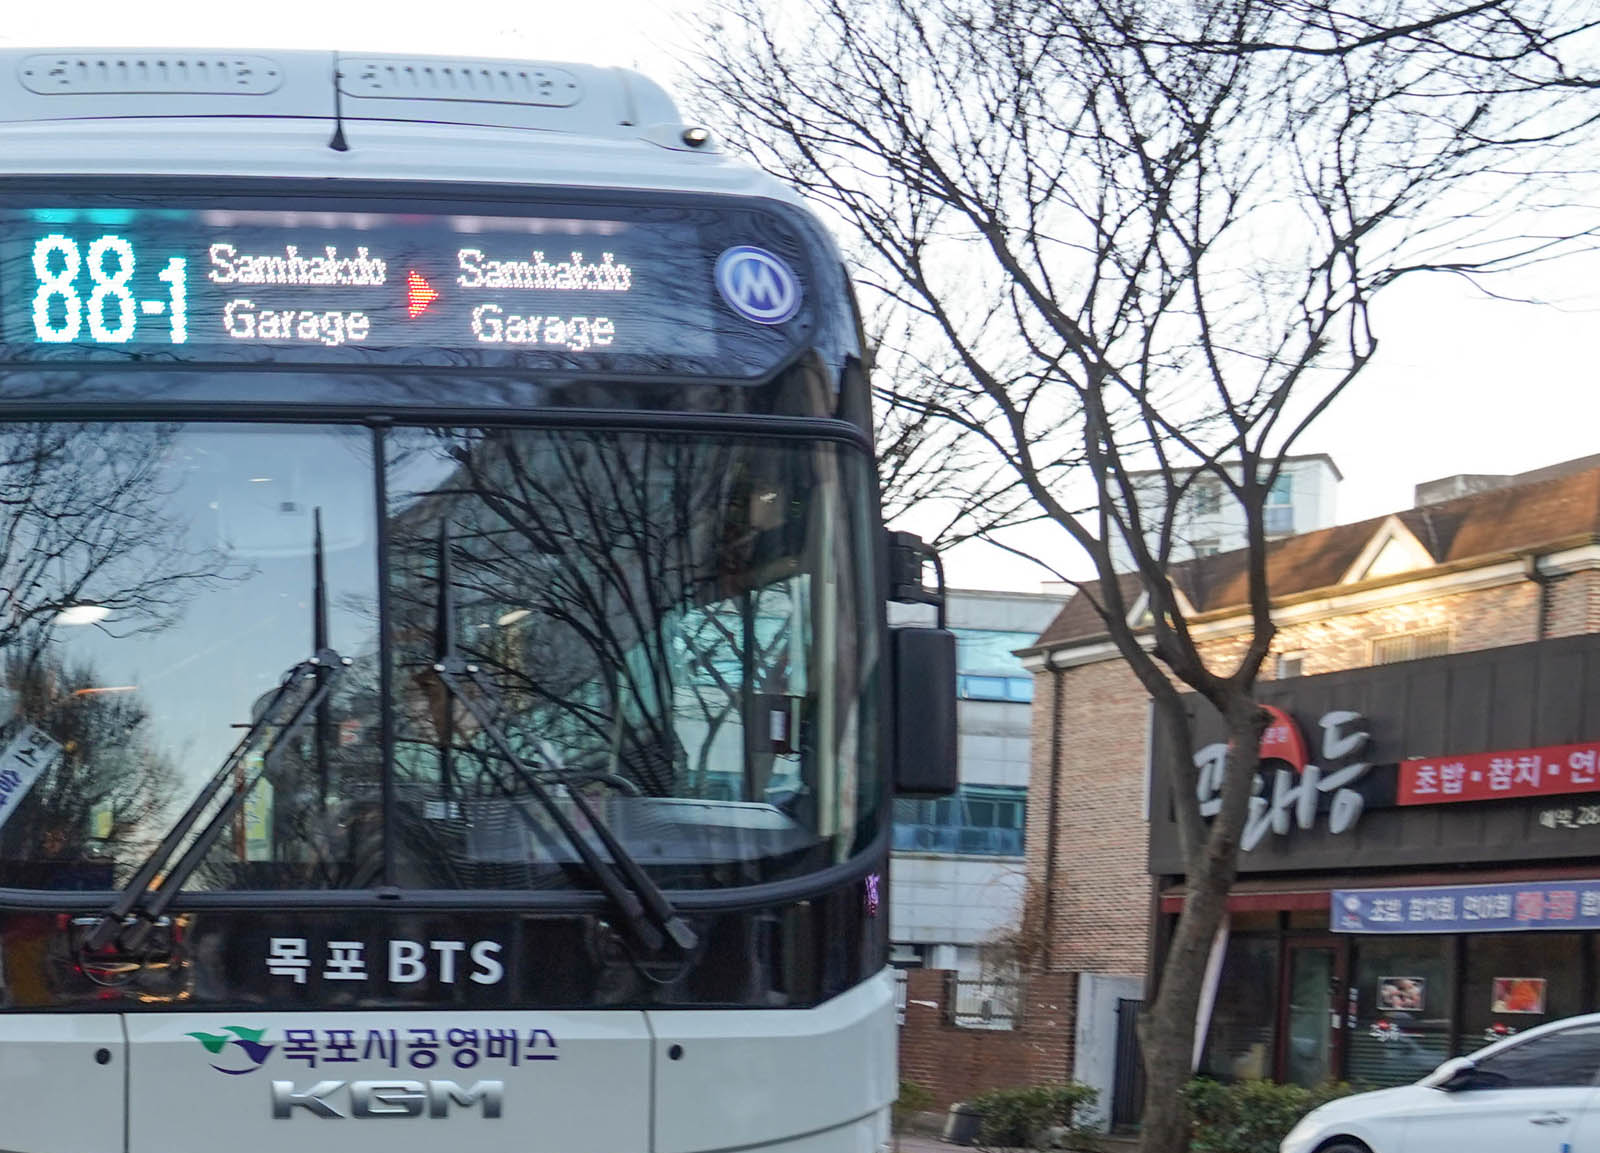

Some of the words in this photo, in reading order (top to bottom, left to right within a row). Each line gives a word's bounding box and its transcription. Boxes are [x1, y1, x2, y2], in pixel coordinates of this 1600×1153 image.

[208, 243, 387, 286] Samhakdo
[456, 249, 632, 291] Samhakdo
[32, 234, 188, 343] 88-1
[223, 299, 370, 346] Garage
[471, 304, 616, 351] Garage
[1413, 763, 1466, 795] 초밥
[1488, 754, 1542, 791] 참치
[1568, 749, 1600, 784] 연
[388, 940, 504, 985] BTS
[283, 1028, 559, 1069] 목포시공영버스
[271, 1080, 505, 1120] KGM
